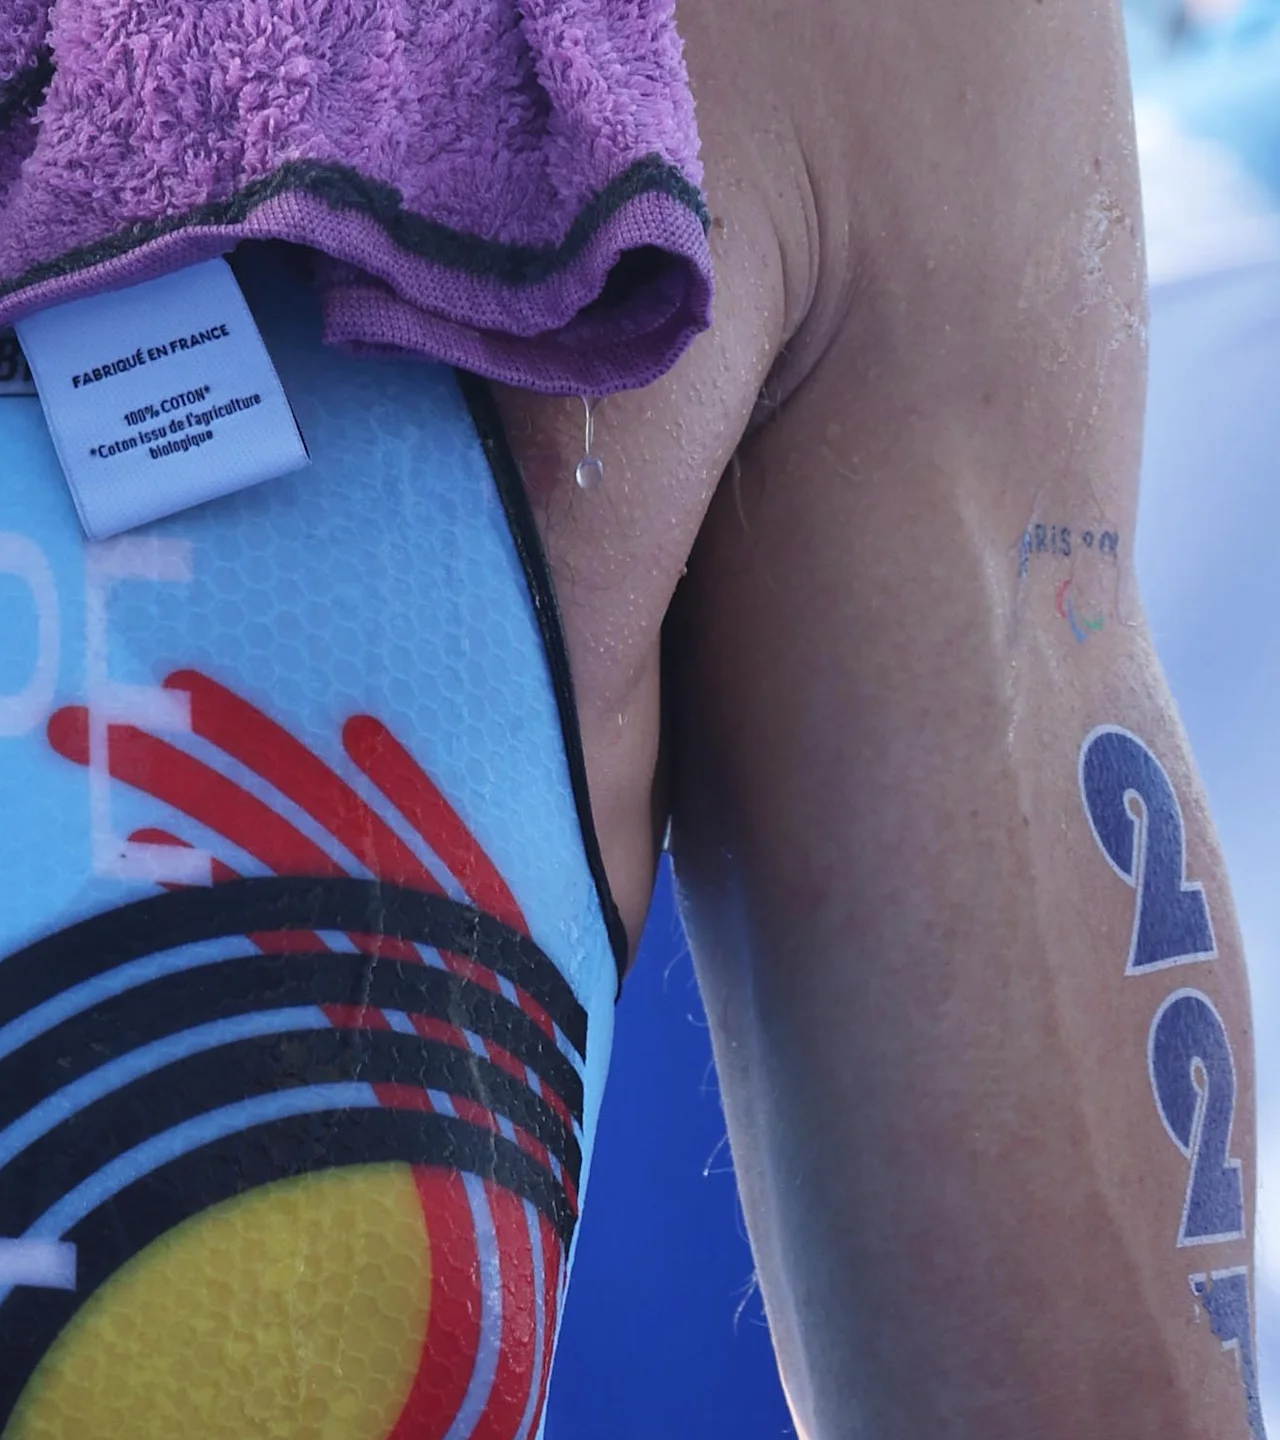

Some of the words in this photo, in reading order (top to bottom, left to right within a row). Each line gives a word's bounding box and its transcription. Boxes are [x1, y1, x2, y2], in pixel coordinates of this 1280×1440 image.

[72, 348, 147, 389] FABRIQUÉ
[147, 344, 169, 363] EN
[169, 324, 231, 354] FRANCE
[123, 404, 161, 427] 100%
[138, 426, 167, 446] issu
[169, 419, 186, 435] de
[186, 392, 262, 429] l'agriculture
[148, 429, 214, 460] biologique
